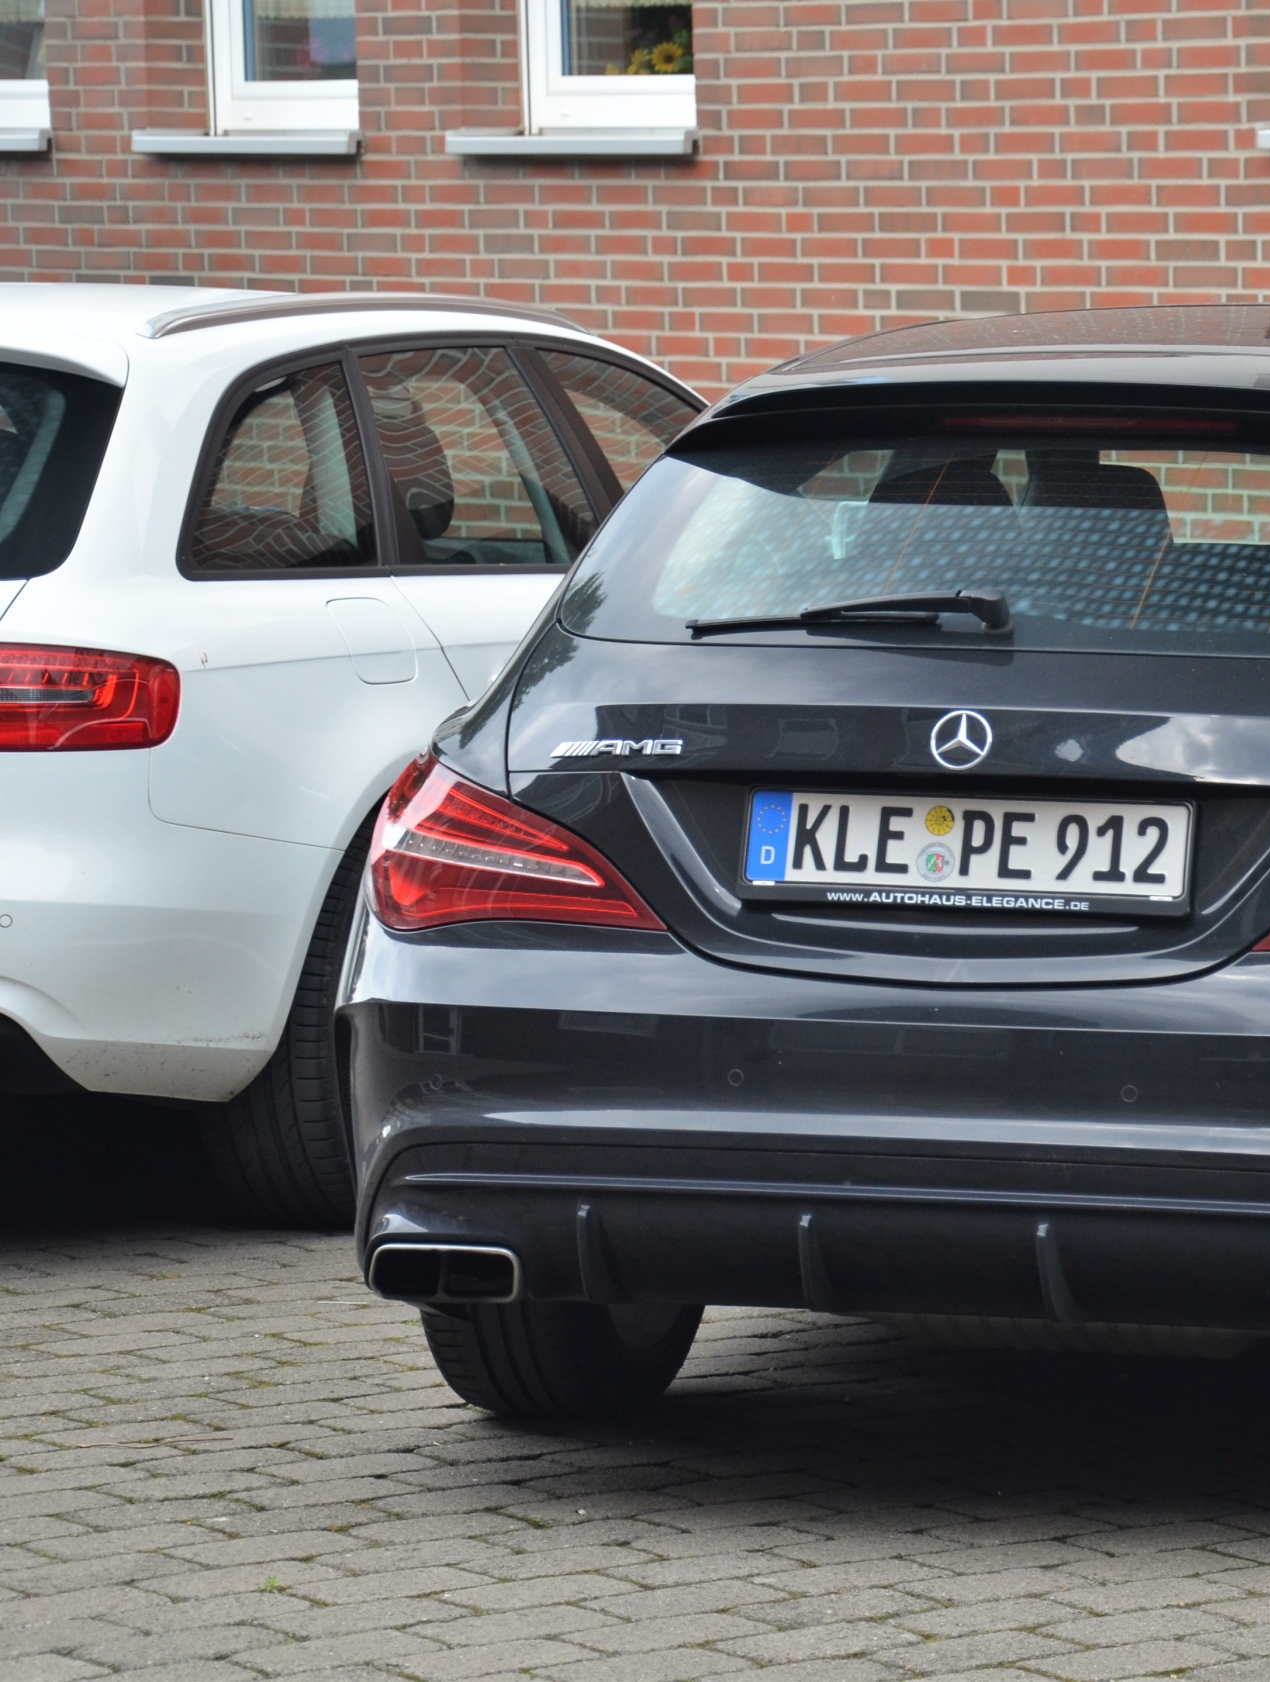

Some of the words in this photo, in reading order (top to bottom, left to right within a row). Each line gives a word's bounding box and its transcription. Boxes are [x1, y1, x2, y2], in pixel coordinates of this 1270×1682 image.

[590, 739, 683, 756] AMG
[792, 803, 913, 874] KLE
[959, 809, 1036, 880] PE
[1055, 814, 1170, 884] 912
[760, 846, 775, 865] D
